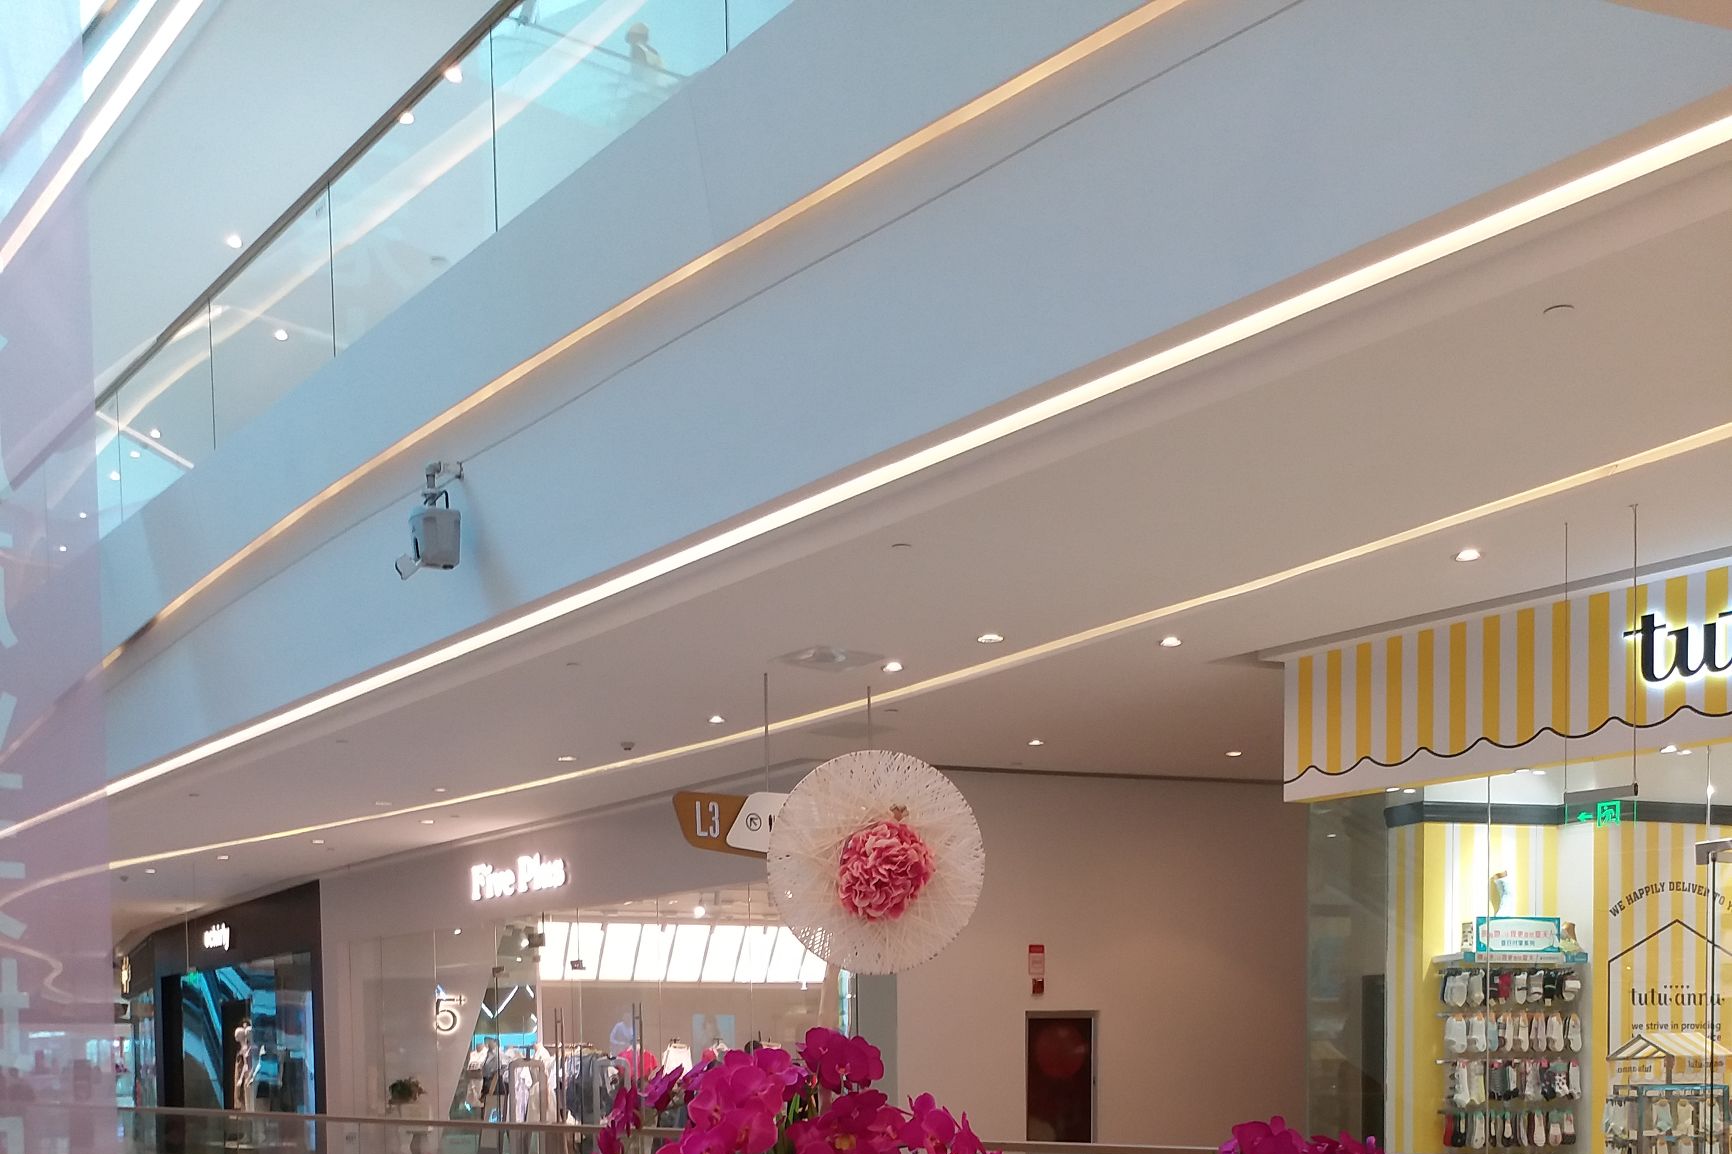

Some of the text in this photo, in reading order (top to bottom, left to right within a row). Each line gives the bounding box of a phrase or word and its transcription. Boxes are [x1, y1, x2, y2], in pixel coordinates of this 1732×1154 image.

[1622, 611, 1732, 683] tu
[695, 801, 720, 838] L3
[470, 851, 567, 901] Five Plus
[1609, 900, 1625, 918] WE
[1625, 882, 1666, 906] HAPPILY
[1646, 1022, 1669, 1030] strive
[1671, 1022, 1679, 1030] in
